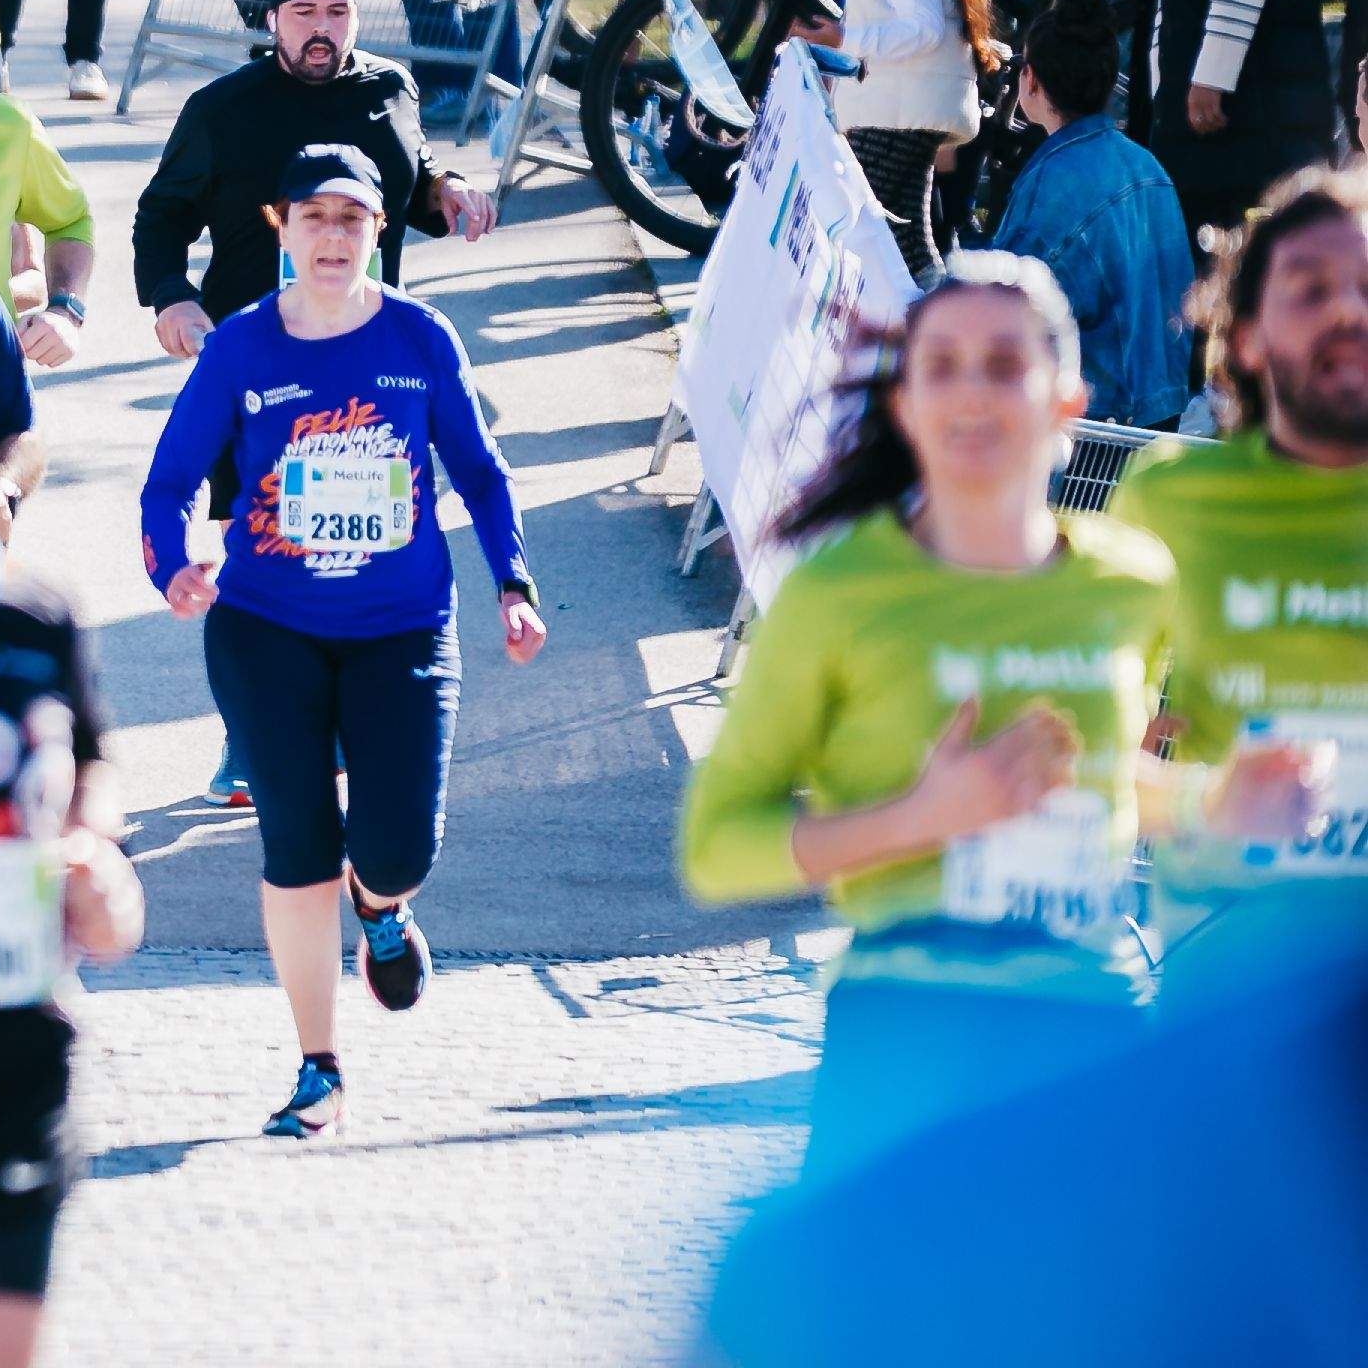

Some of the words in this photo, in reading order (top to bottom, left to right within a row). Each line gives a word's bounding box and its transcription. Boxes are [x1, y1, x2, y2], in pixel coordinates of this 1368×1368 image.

[376, 375, 427, 390] OYSHO
[334, 470, 384, 481] MetLife
[311, 513, 382, 541] 2386
